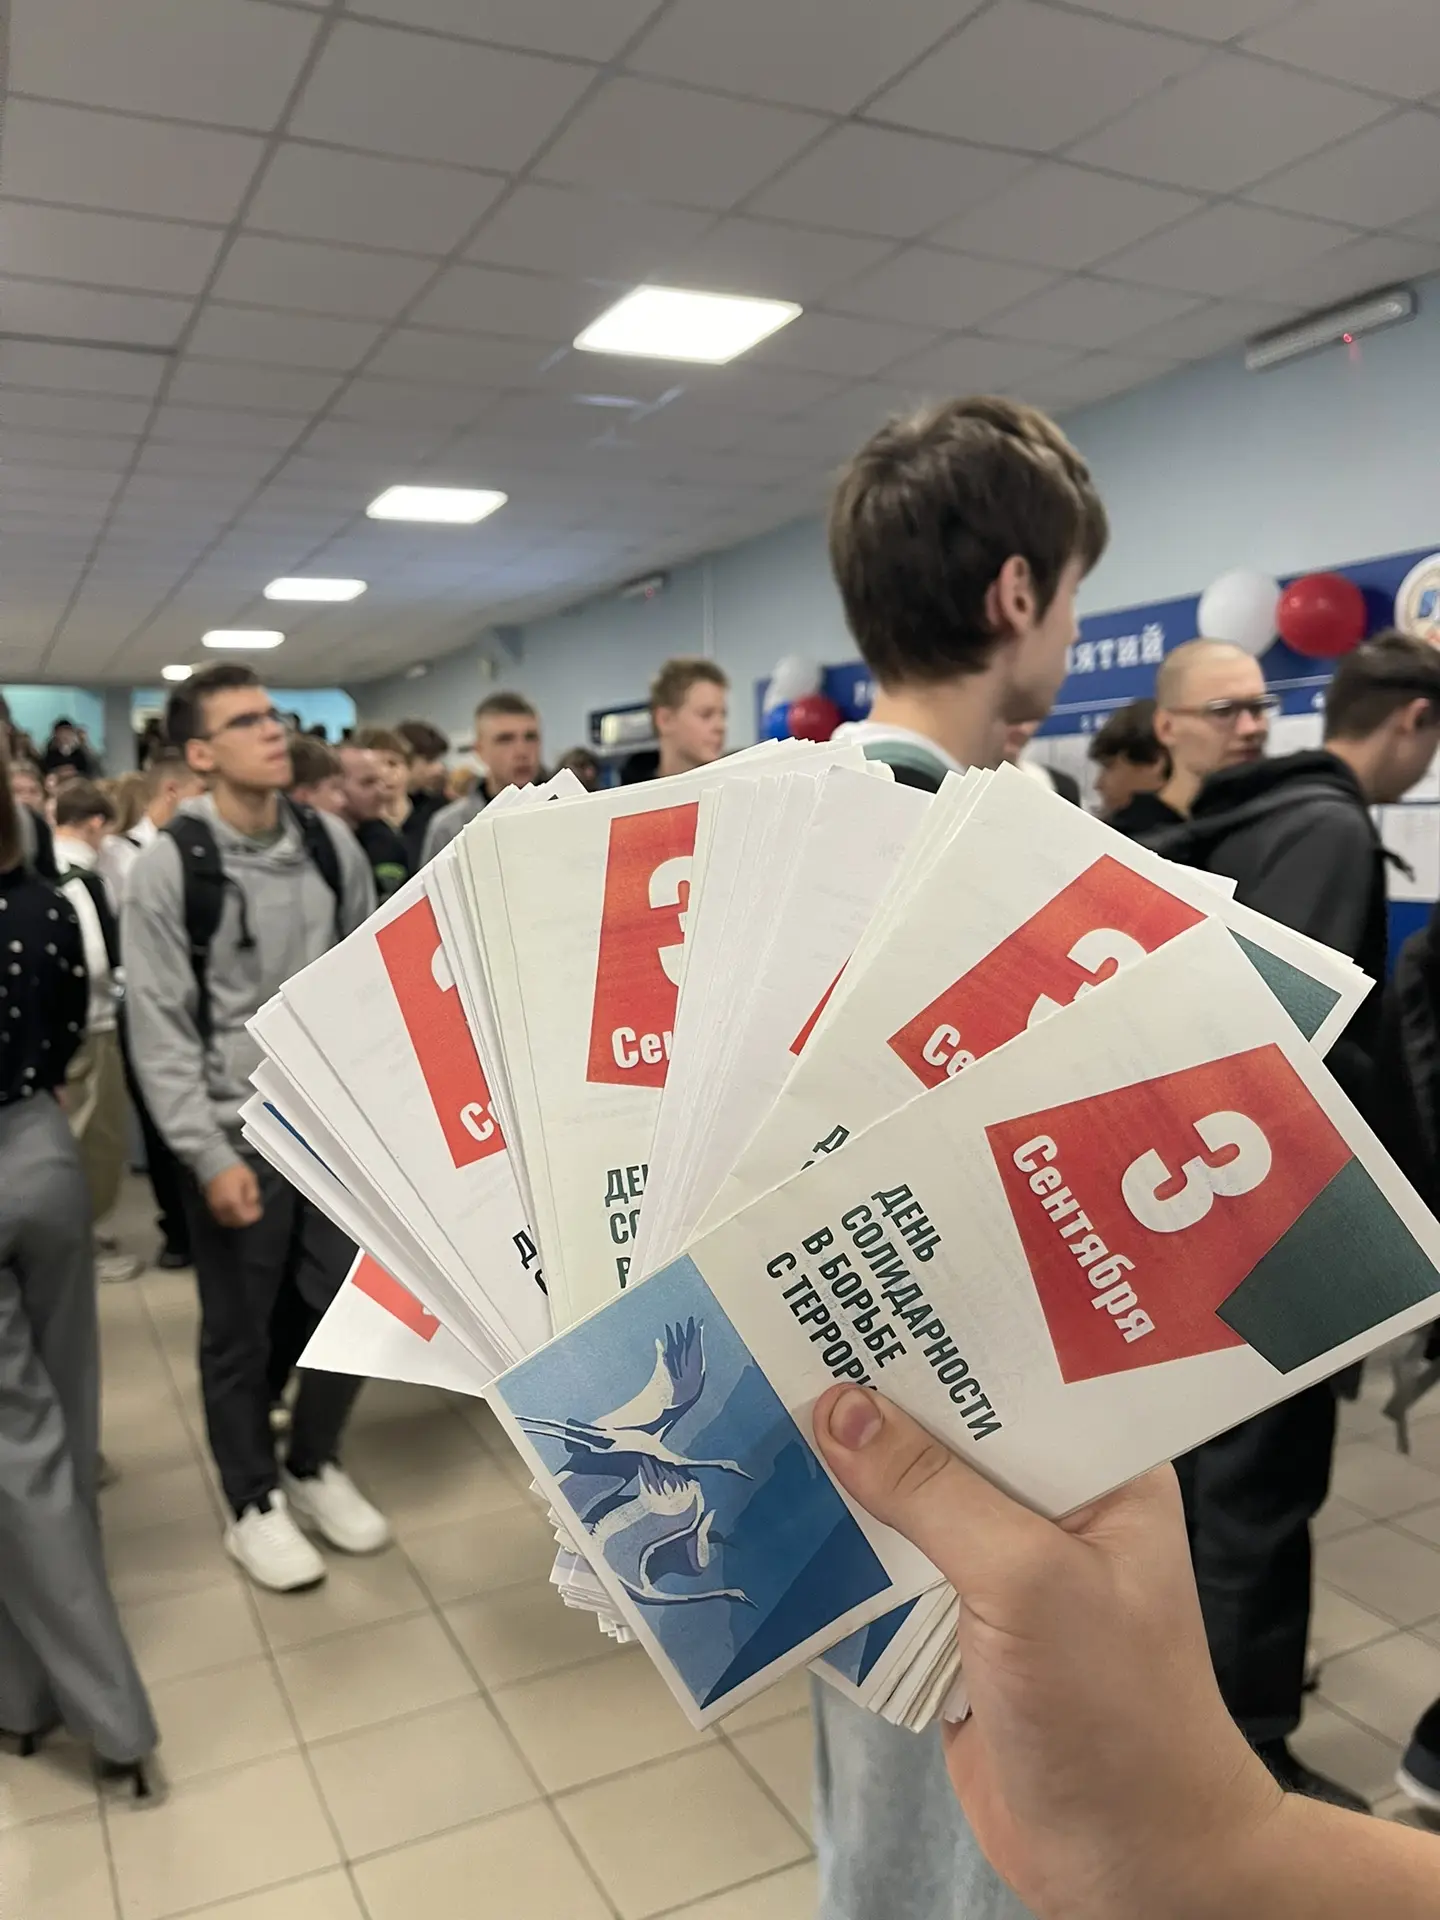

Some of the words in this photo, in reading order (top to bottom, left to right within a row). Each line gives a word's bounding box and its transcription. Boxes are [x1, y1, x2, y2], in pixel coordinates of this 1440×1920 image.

[604, 1164, 649, 1207] ДЕ
[871, 1183, 942, 1263] ДЕНЬ
[1013, 1134, 1156, 1344] Сентября
[1121, 1110, 1272, 1233] 3
[766, 1252, 797, 1279] С
[782, 1273, 878, 1391] ТЕРРОР
[801, 1226, 834, 1256] В
[818, 1252, 907, 1369] БОРЬБЕ
[841, 1204, 1003, 1442] СОЛИДАРНОСТИ
